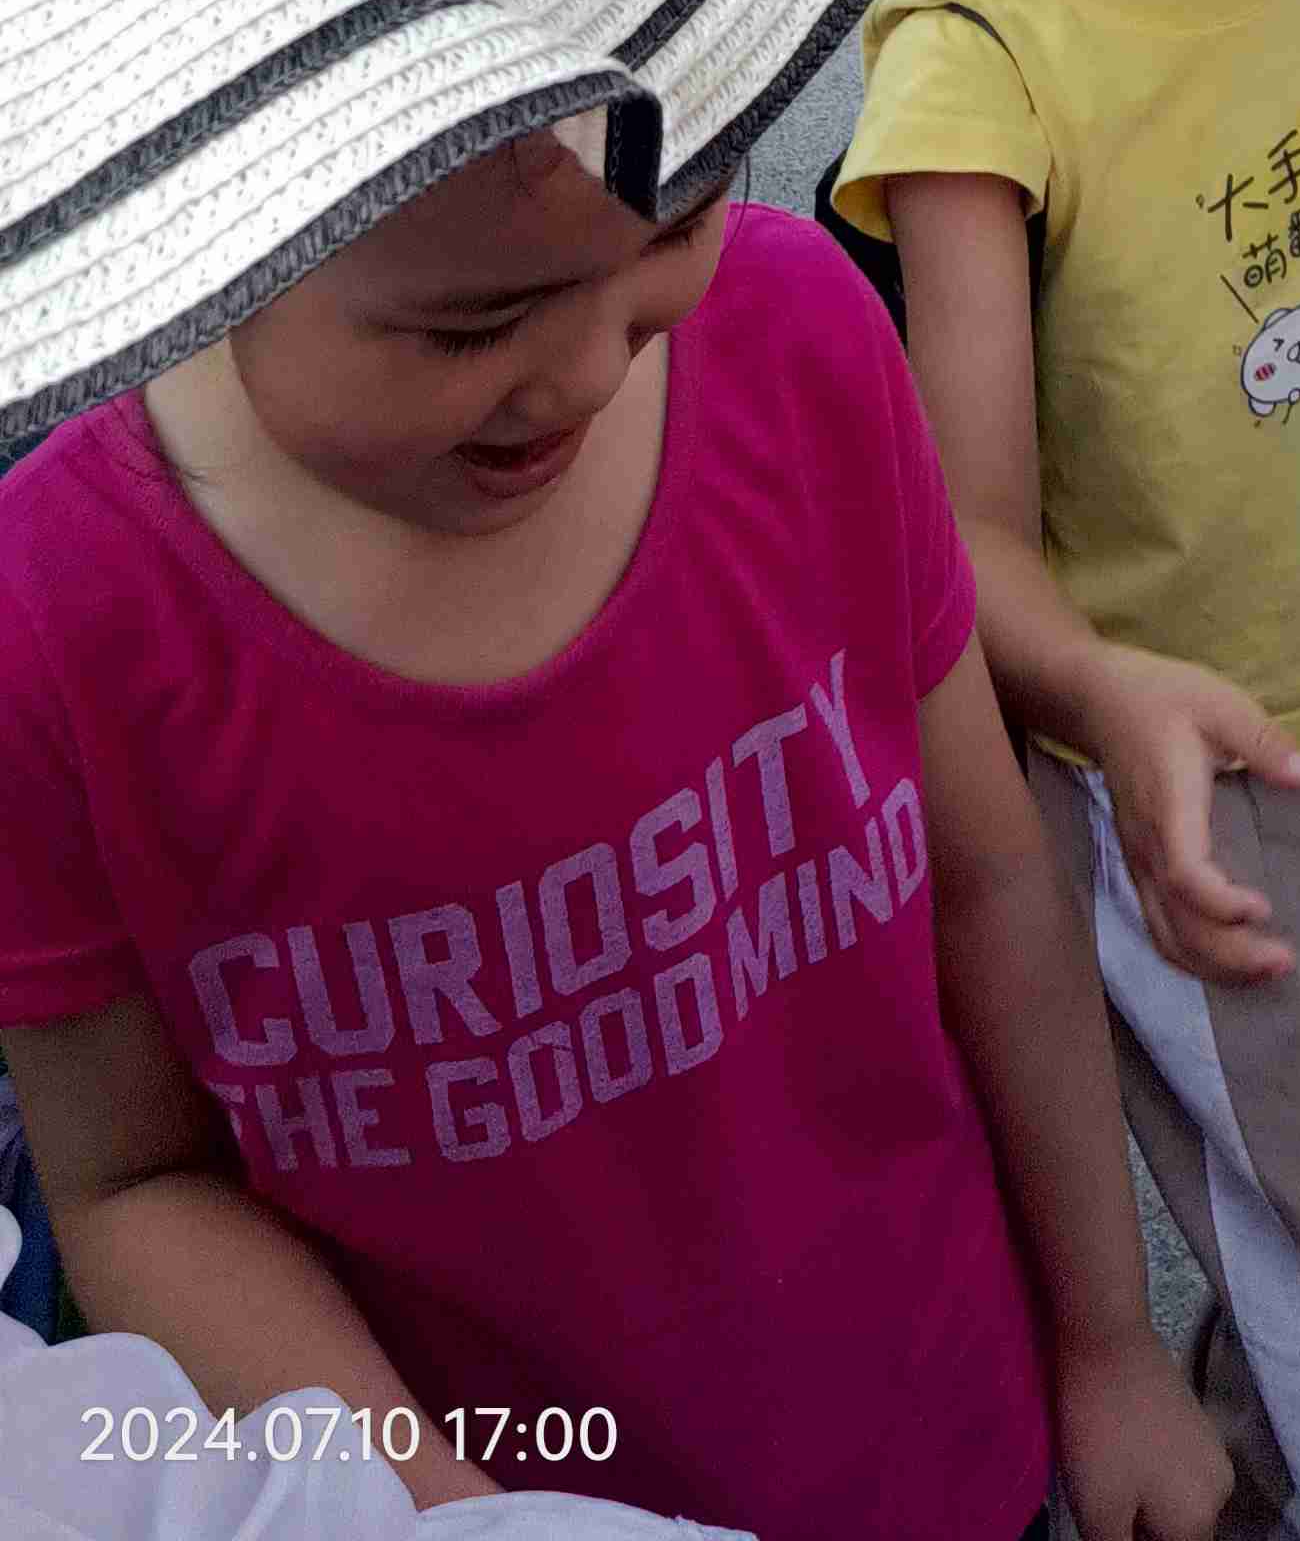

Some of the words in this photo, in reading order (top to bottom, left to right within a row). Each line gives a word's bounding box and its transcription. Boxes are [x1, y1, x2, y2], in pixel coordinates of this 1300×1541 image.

[187, 648, 872, 1067] CURIOSITY
[426, 952, 724, 1163] GOOD
[725, 777, 929, 1021] MIND
